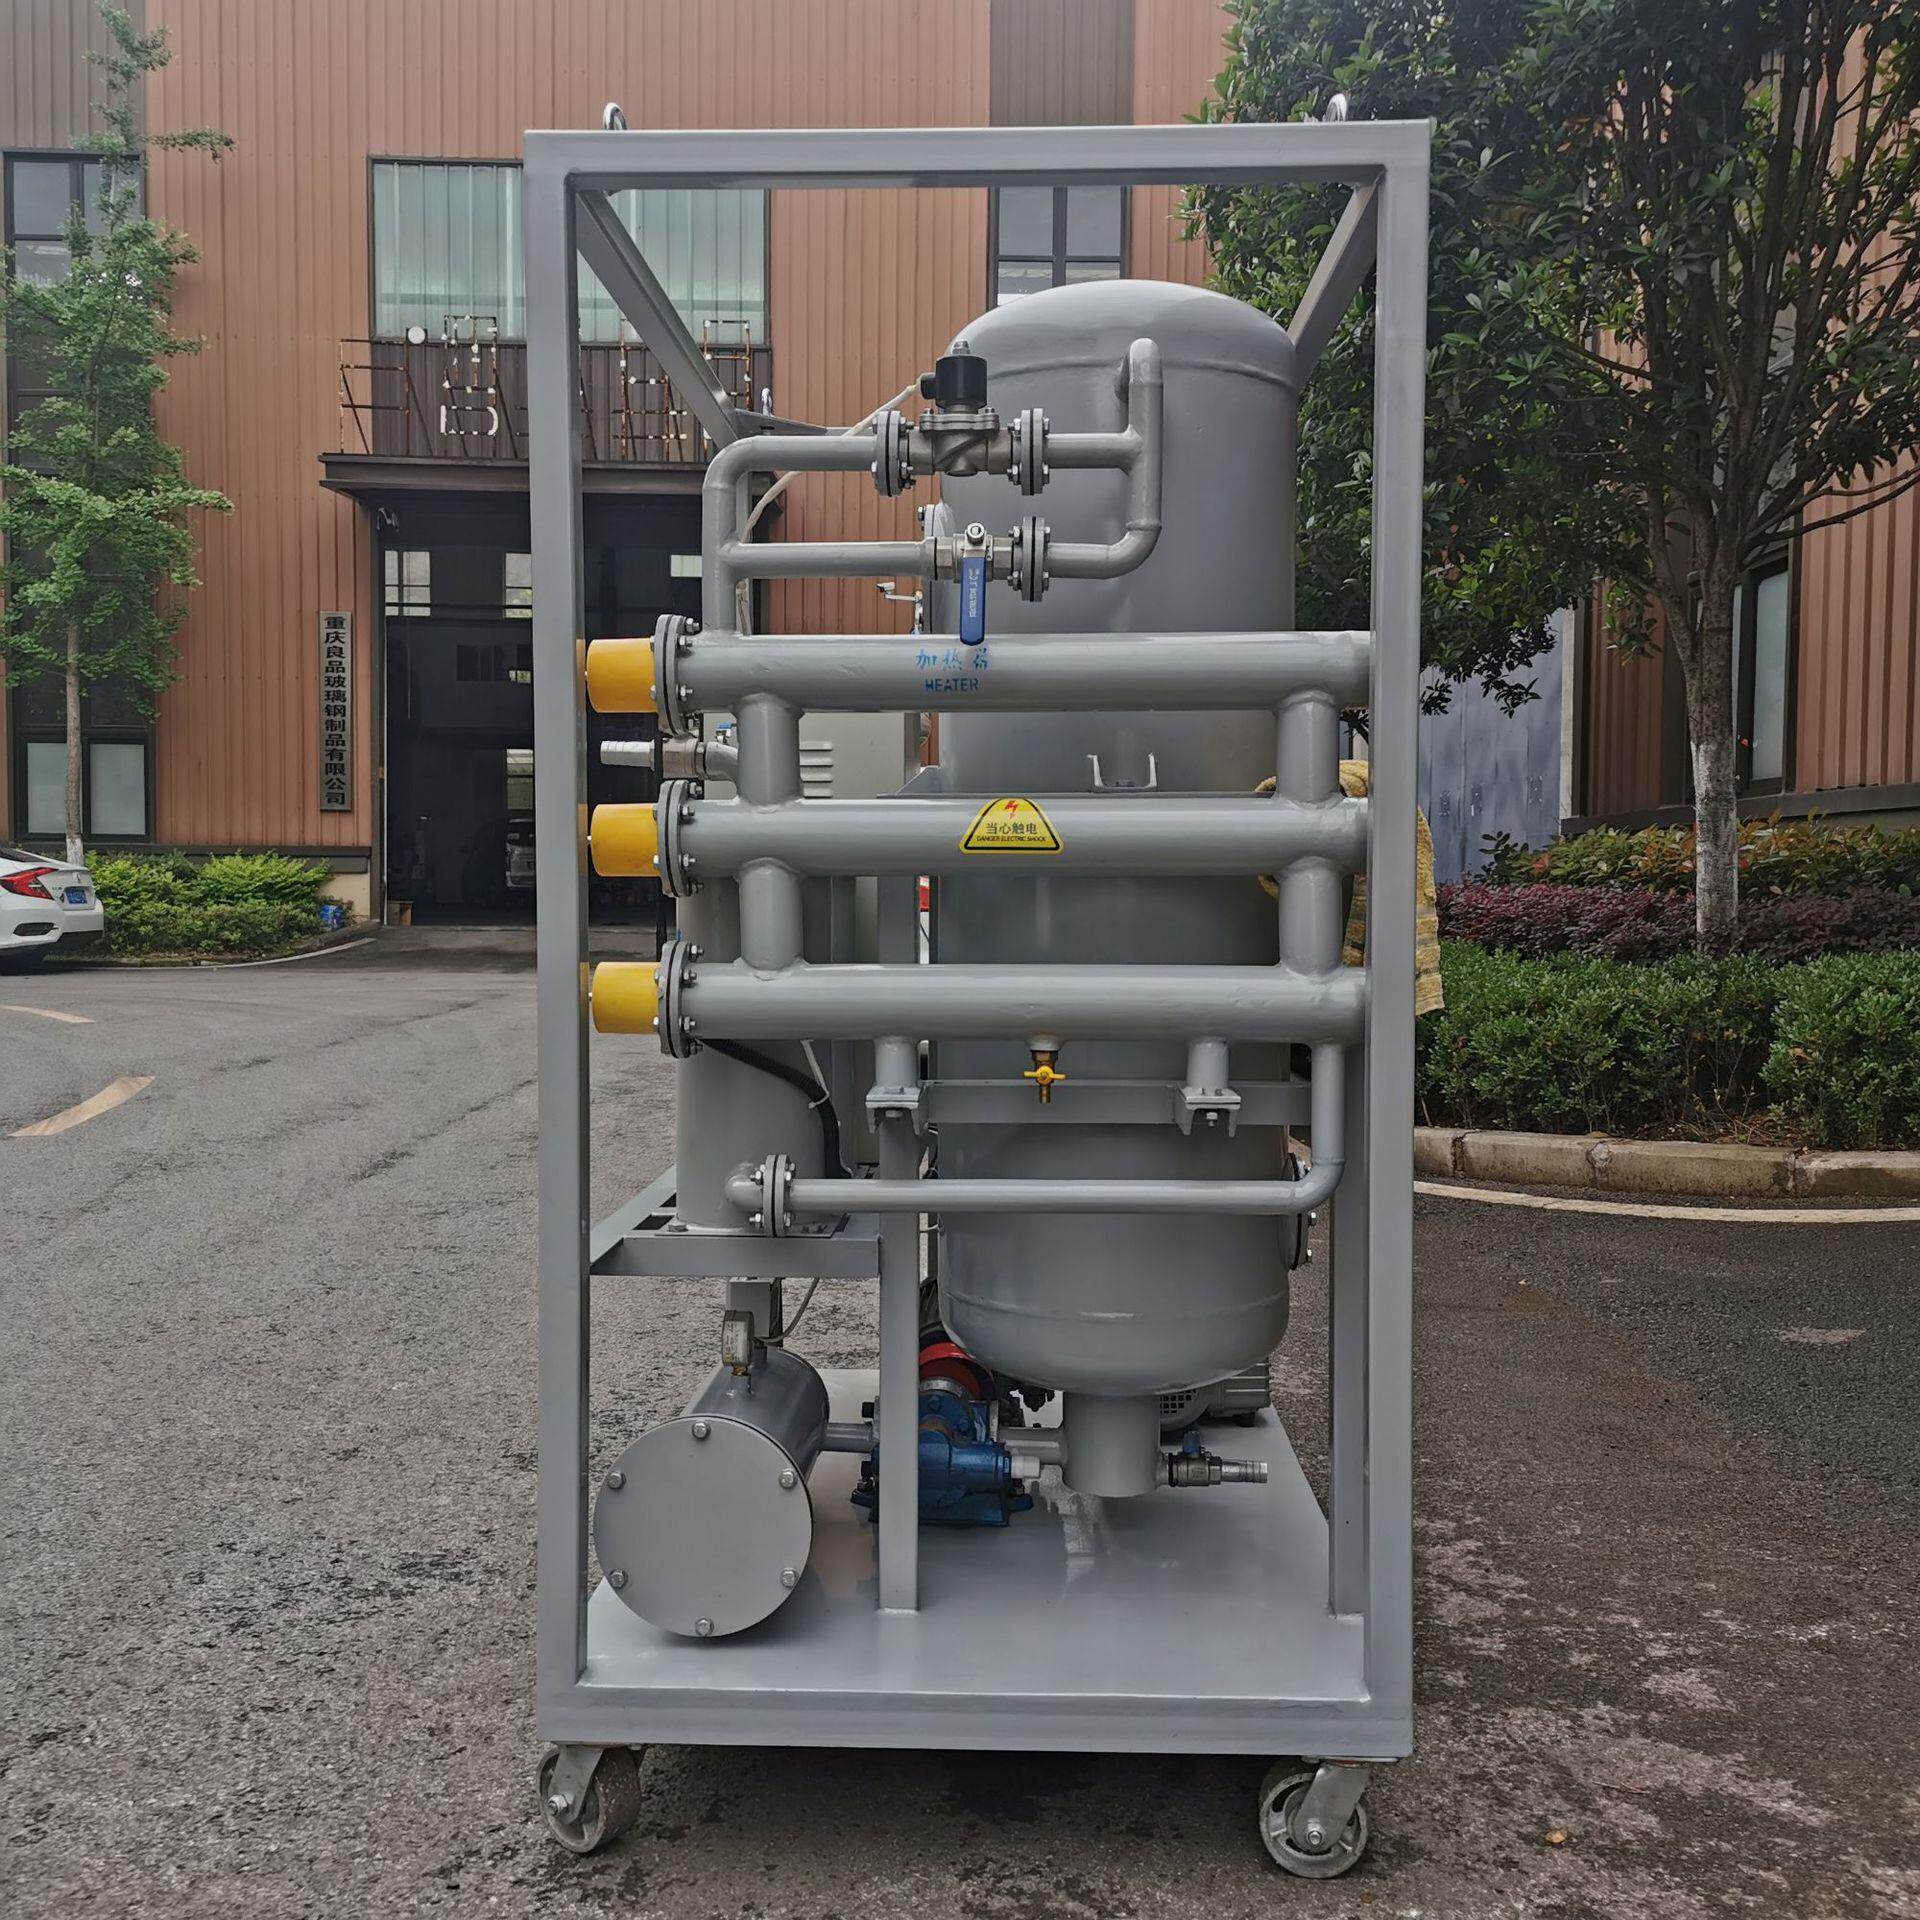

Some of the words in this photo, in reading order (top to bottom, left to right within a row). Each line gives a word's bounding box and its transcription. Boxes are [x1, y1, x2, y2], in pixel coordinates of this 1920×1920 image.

[925, 678, 979, 692] HEATER
[324, 616, 347, 806] 重庆良品玻璃钢制品有限公司
[986, 822, 1038, 835] 当心触电
